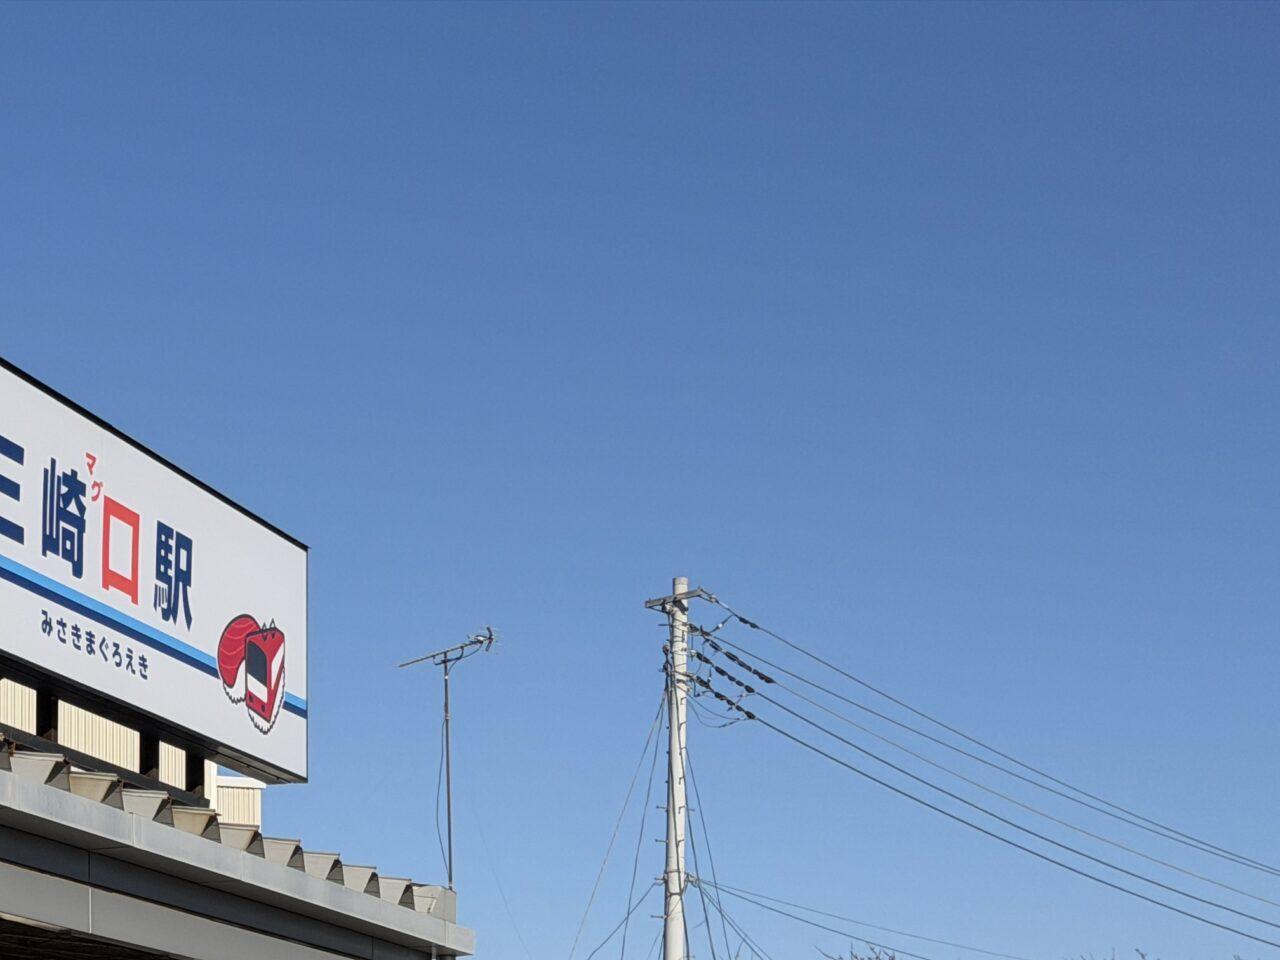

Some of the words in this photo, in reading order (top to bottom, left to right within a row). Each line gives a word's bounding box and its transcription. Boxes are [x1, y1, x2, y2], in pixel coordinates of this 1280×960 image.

[40, 609, 149, 680] みさきまぐろえき
